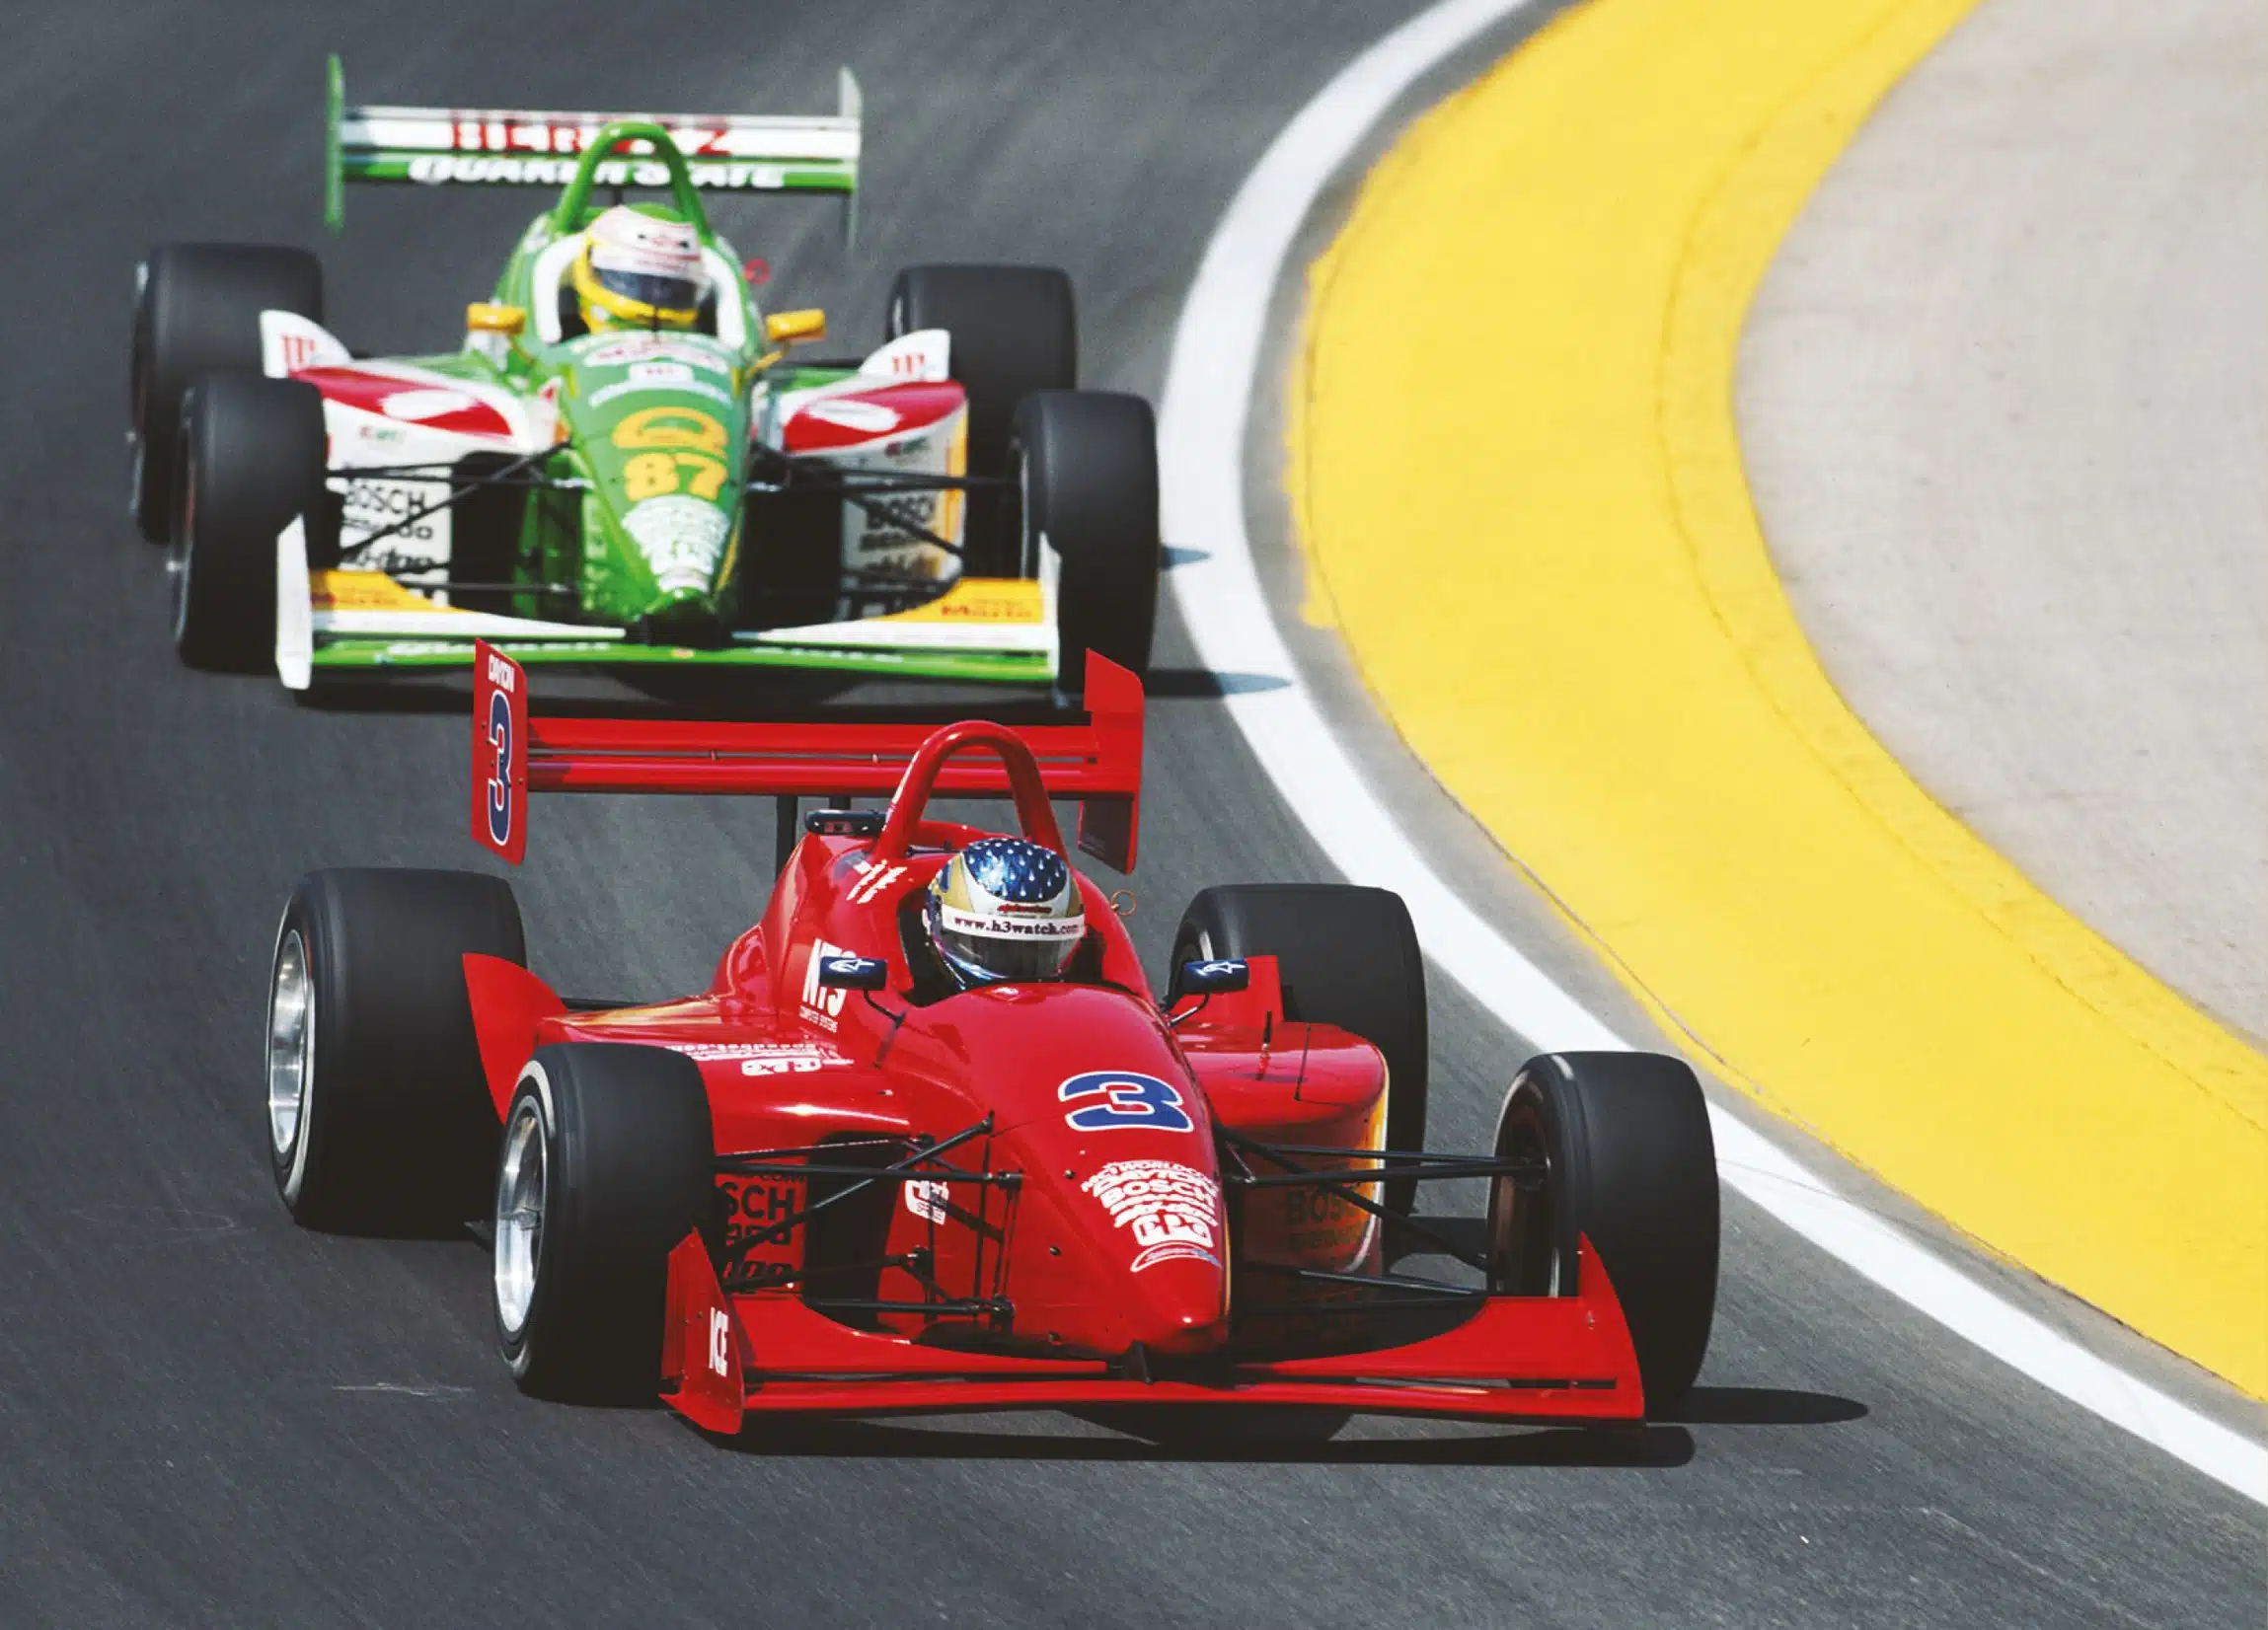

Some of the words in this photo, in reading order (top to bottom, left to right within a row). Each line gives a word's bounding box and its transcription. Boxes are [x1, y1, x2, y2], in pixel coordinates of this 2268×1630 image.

[449, 111, 732, 156] HERZ
[408, 155, 628, 185] QUAKR
[630, 162, 786, 188] SATE
[624, 452, 727, 501] 87
[488, 690, 513, 847] 3
[1058, 1071, 1194, 1132] 3
[721, 1182, 794, 1221] SCH
[1100, 1179, 1216, 1210] BOSCH
